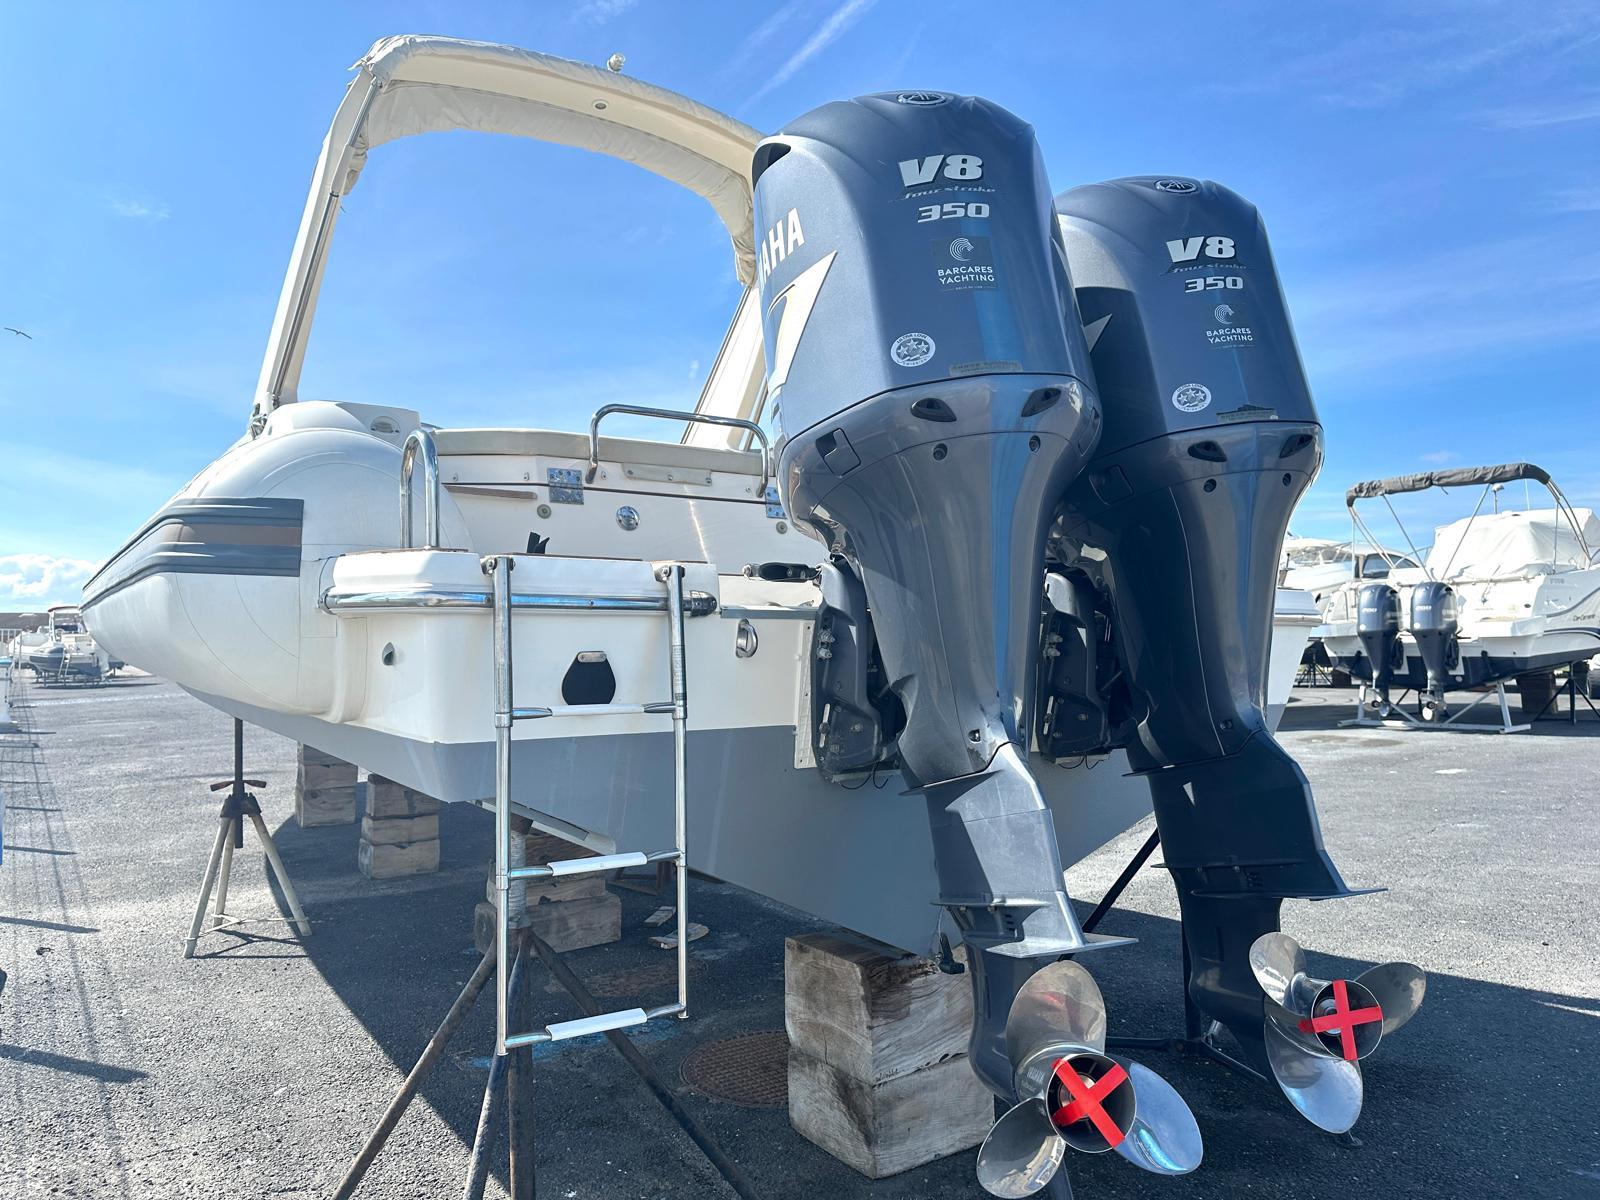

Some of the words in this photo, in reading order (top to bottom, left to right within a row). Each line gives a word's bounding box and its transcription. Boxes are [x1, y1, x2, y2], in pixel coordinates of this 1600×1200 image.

[898, 154, 983, 188] V8
[917, 202, 990, 223] 350
[1165, 236, 1236, 263] V8
[937, 265, 993, 277] BARCARES
[939, 274, 995, 285] YACHTING
[1184, 276, 1244, 293] 350
[1206, 327, 1252, 337] BARCARES
[1208, 335, 1254, 344] YACHTING
